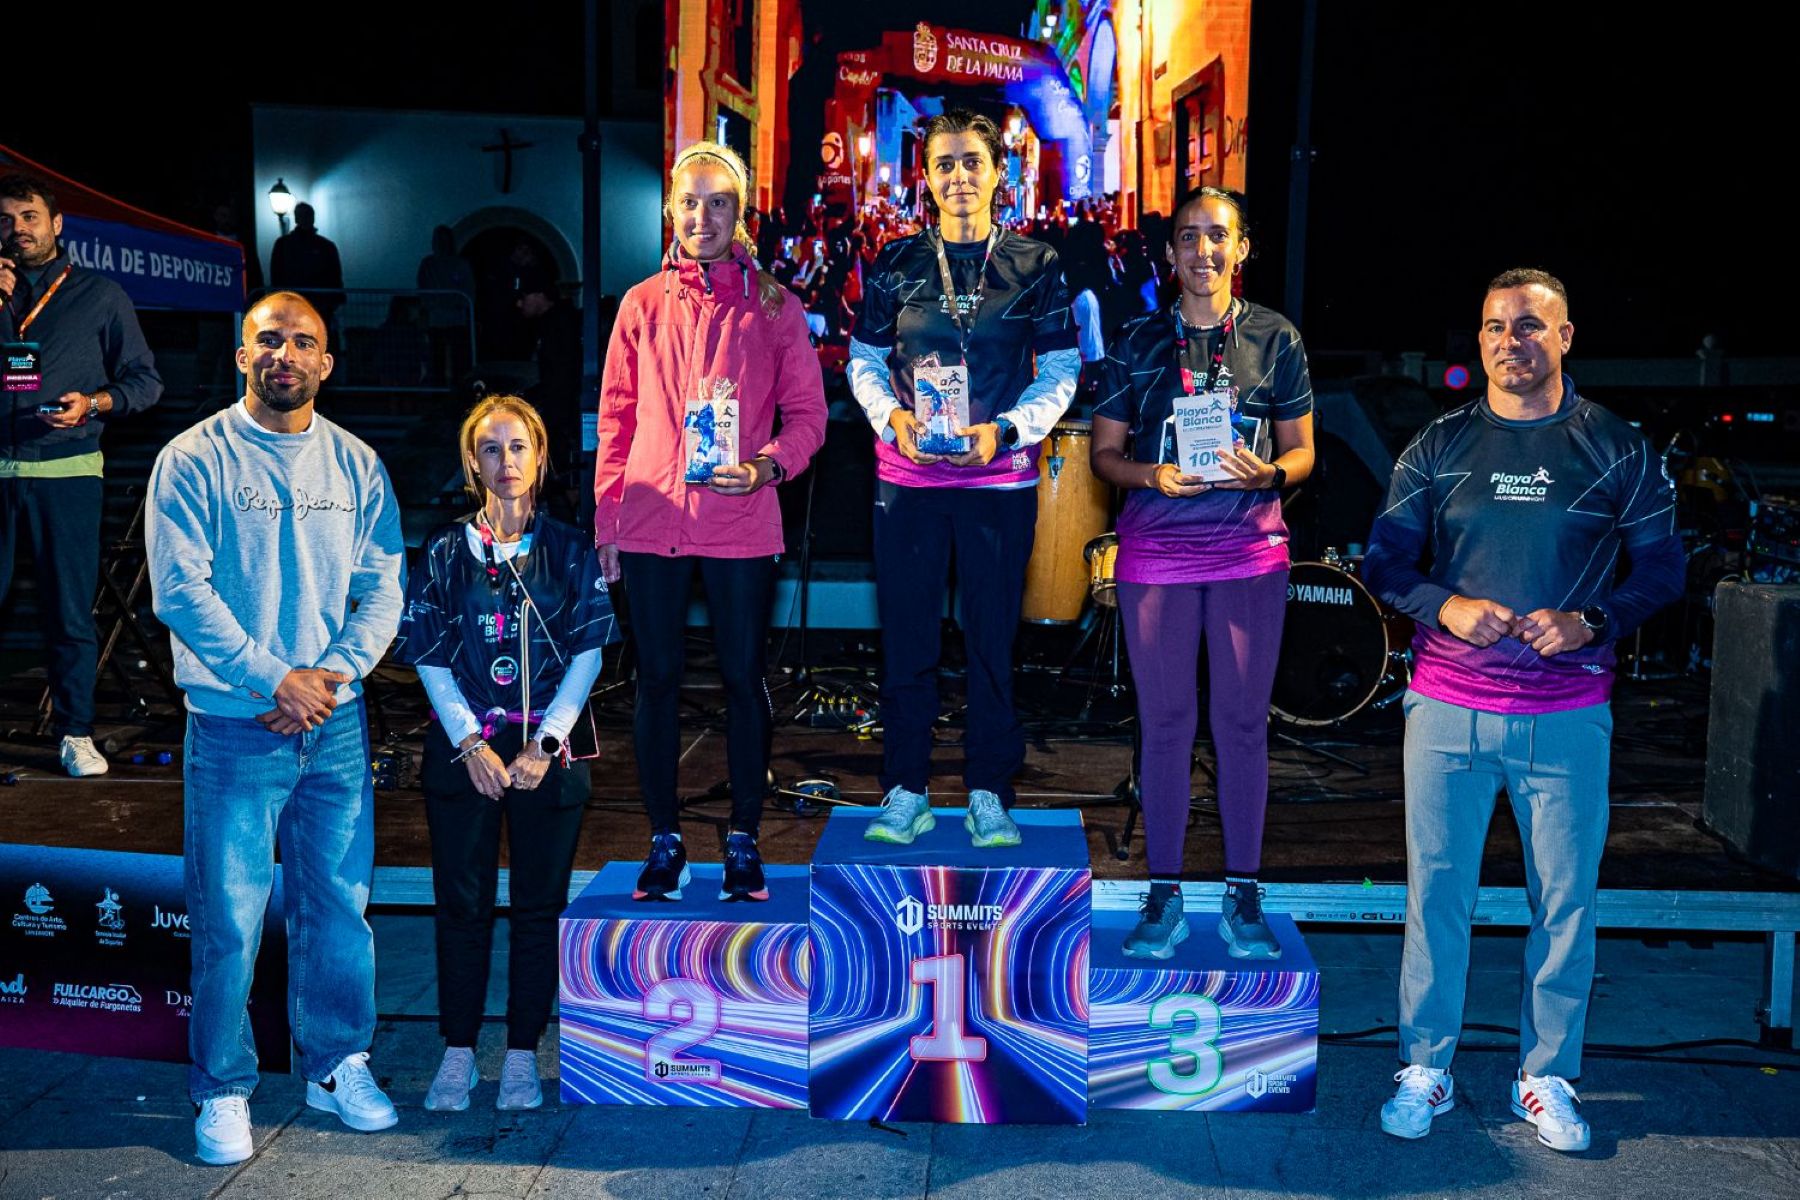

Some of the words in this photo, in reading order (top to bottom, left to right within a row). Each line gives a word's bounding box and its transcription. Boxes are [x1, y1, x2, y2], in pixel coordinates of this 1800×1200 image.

[946, 32, 989, 54] SANTA
[990, 41, 1024, 61] CRUZ
[946, 55, 964, 74] DE
[965, 58, 981, 76] LA
[983, 60, 1024, 82] PALMA
[67, 236, 116, 272] ALÍA
[121, 247, 146, 276] DE
[150, 252, 234, 288] DEPORTES
[1176, 406, 1209, 418] Playa
[1182, 415, 1222, 427] Blanca
[1490, 472, 1532, 485] Playa
[1495, 483, 1547, 495] Blanca
[233, 486, 294, 520] Pepe
[294, 488, 356, 521] Jeans
[1295, 584, 1354, 606] YAMAHA
[151, 904, 191, 930] Juve
[927, 904, 1003, 920] SUMMITS
[927, 921, 963, 930] SPORTS
[966, 922, 1003, 931] EVENTS
[53, 983, 129, 1001] FULLCARGO
[59, 997, 88, 1009] Alquiler
[89, 1000, 99, 1009] de
[100, 1001, 142, 1013] Furgonetas
[910, 954, 986, 1062] 1
[643, 978, 722, 1083] 2
[1148, 992, 1222, 1096] 3
[670, 1064, 711, 1072] SUMMITS
